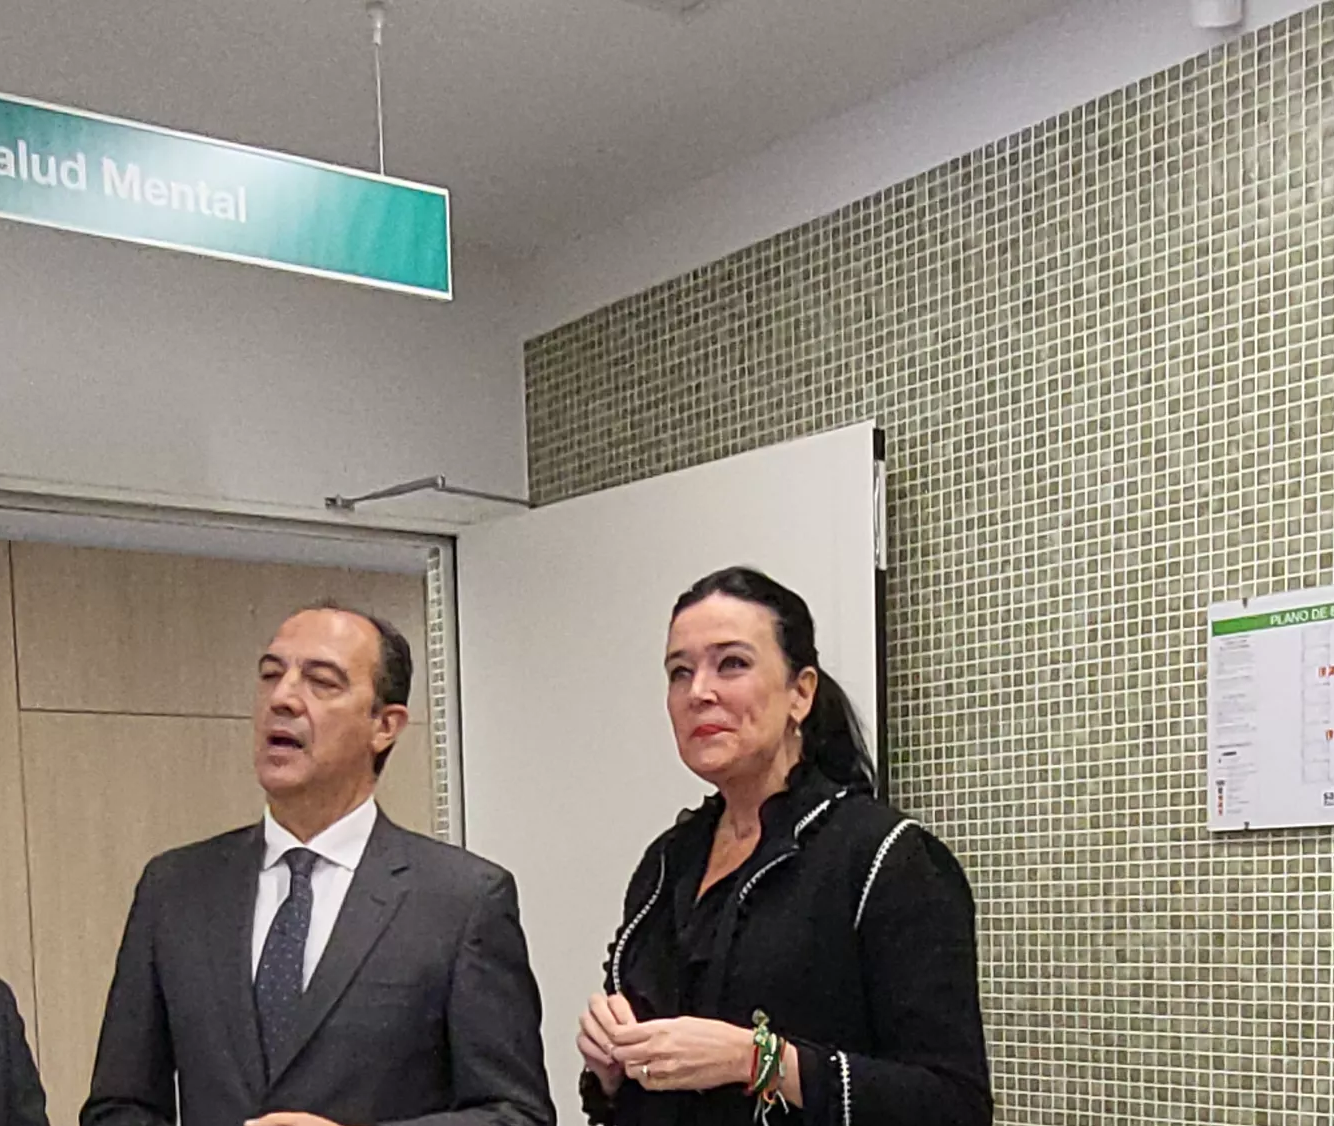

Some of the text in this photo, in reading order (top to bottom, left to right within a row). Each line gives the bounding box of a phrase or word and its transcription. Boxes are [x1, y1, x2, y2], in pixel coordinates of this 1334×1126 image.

[103, 157, 247, 222] Mental
[1270, 610, 1308, 626] PLANO
[1311, 606, 1327, 620] DE
